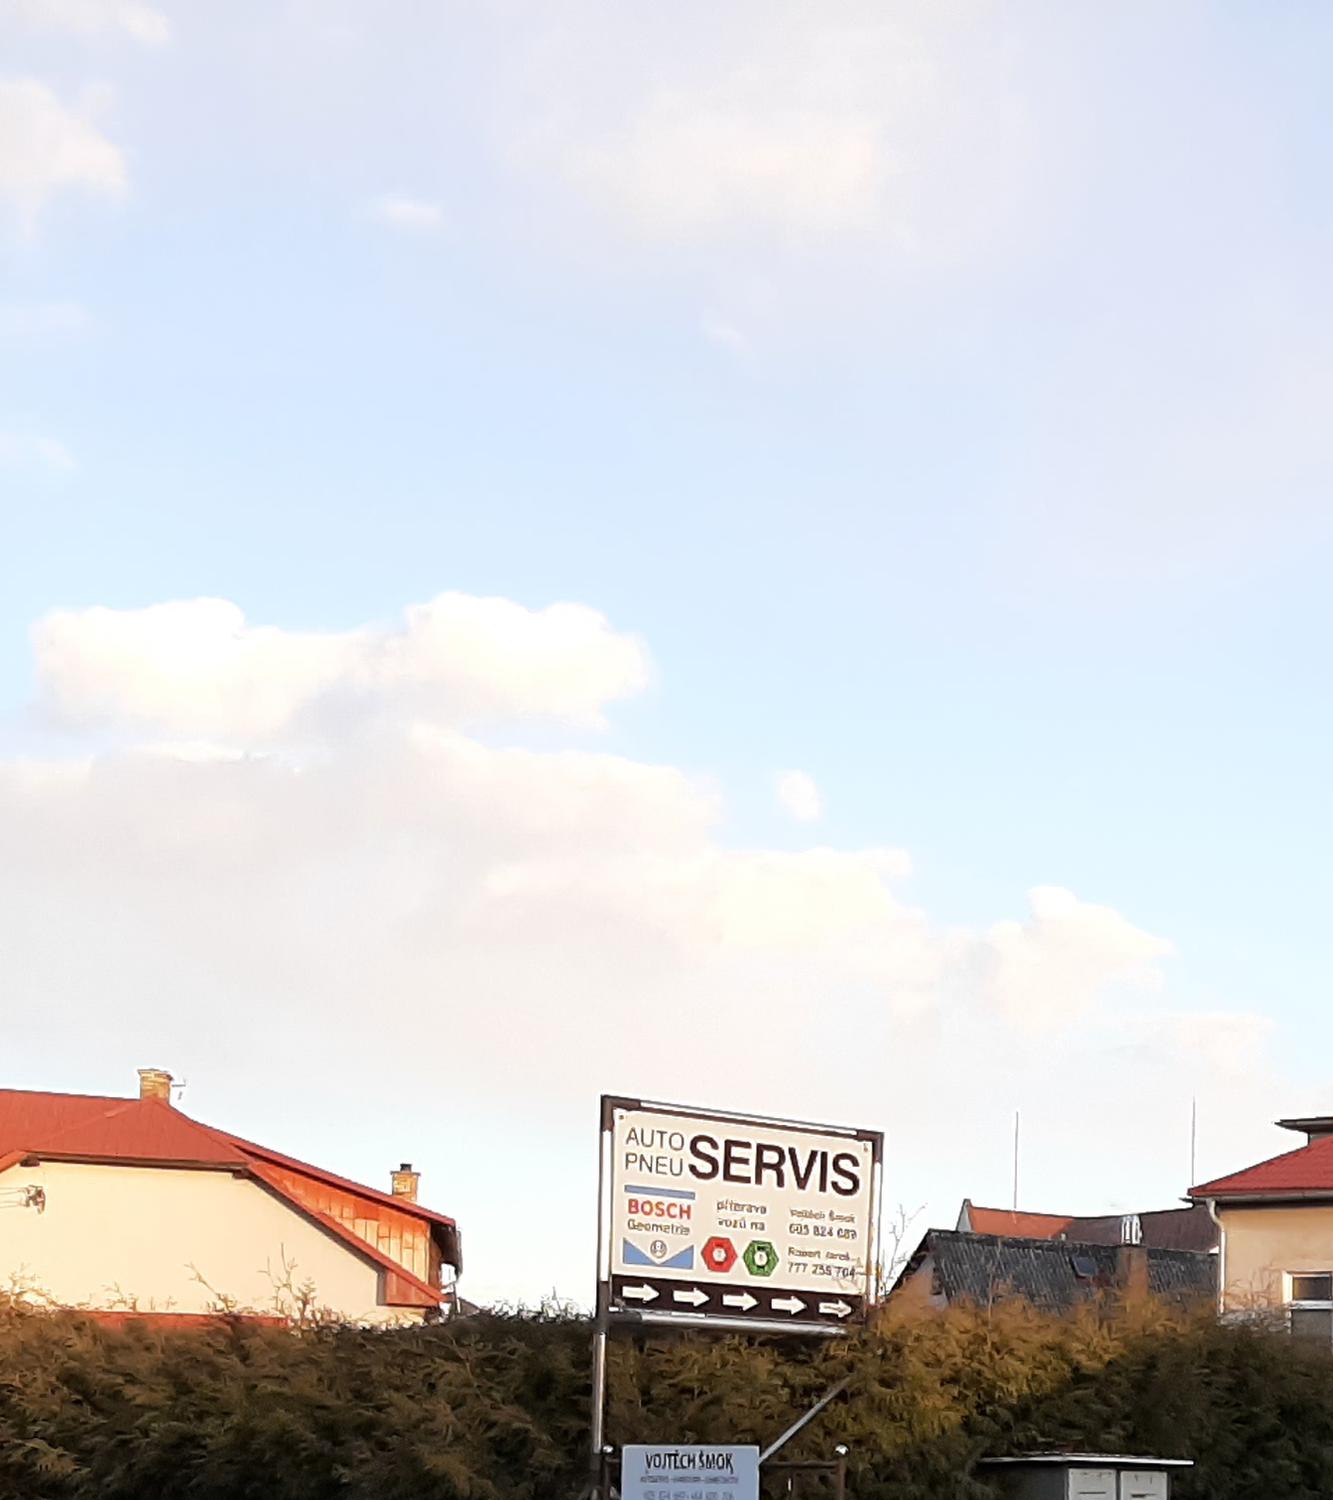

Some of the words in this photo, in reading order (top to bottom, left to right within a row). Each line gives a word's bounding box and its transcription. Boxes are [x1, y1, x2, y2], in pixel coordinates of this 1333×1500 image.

[625, 1127, 685, 1151] AUTO
[625, 1152, 683, 1176] PNEU
[688, 1134, 860, 1196] SERVIS
[628, 1198, 691, 1220] BOSCH
[645, 1450, 697, 1470] VOJTĚCH
